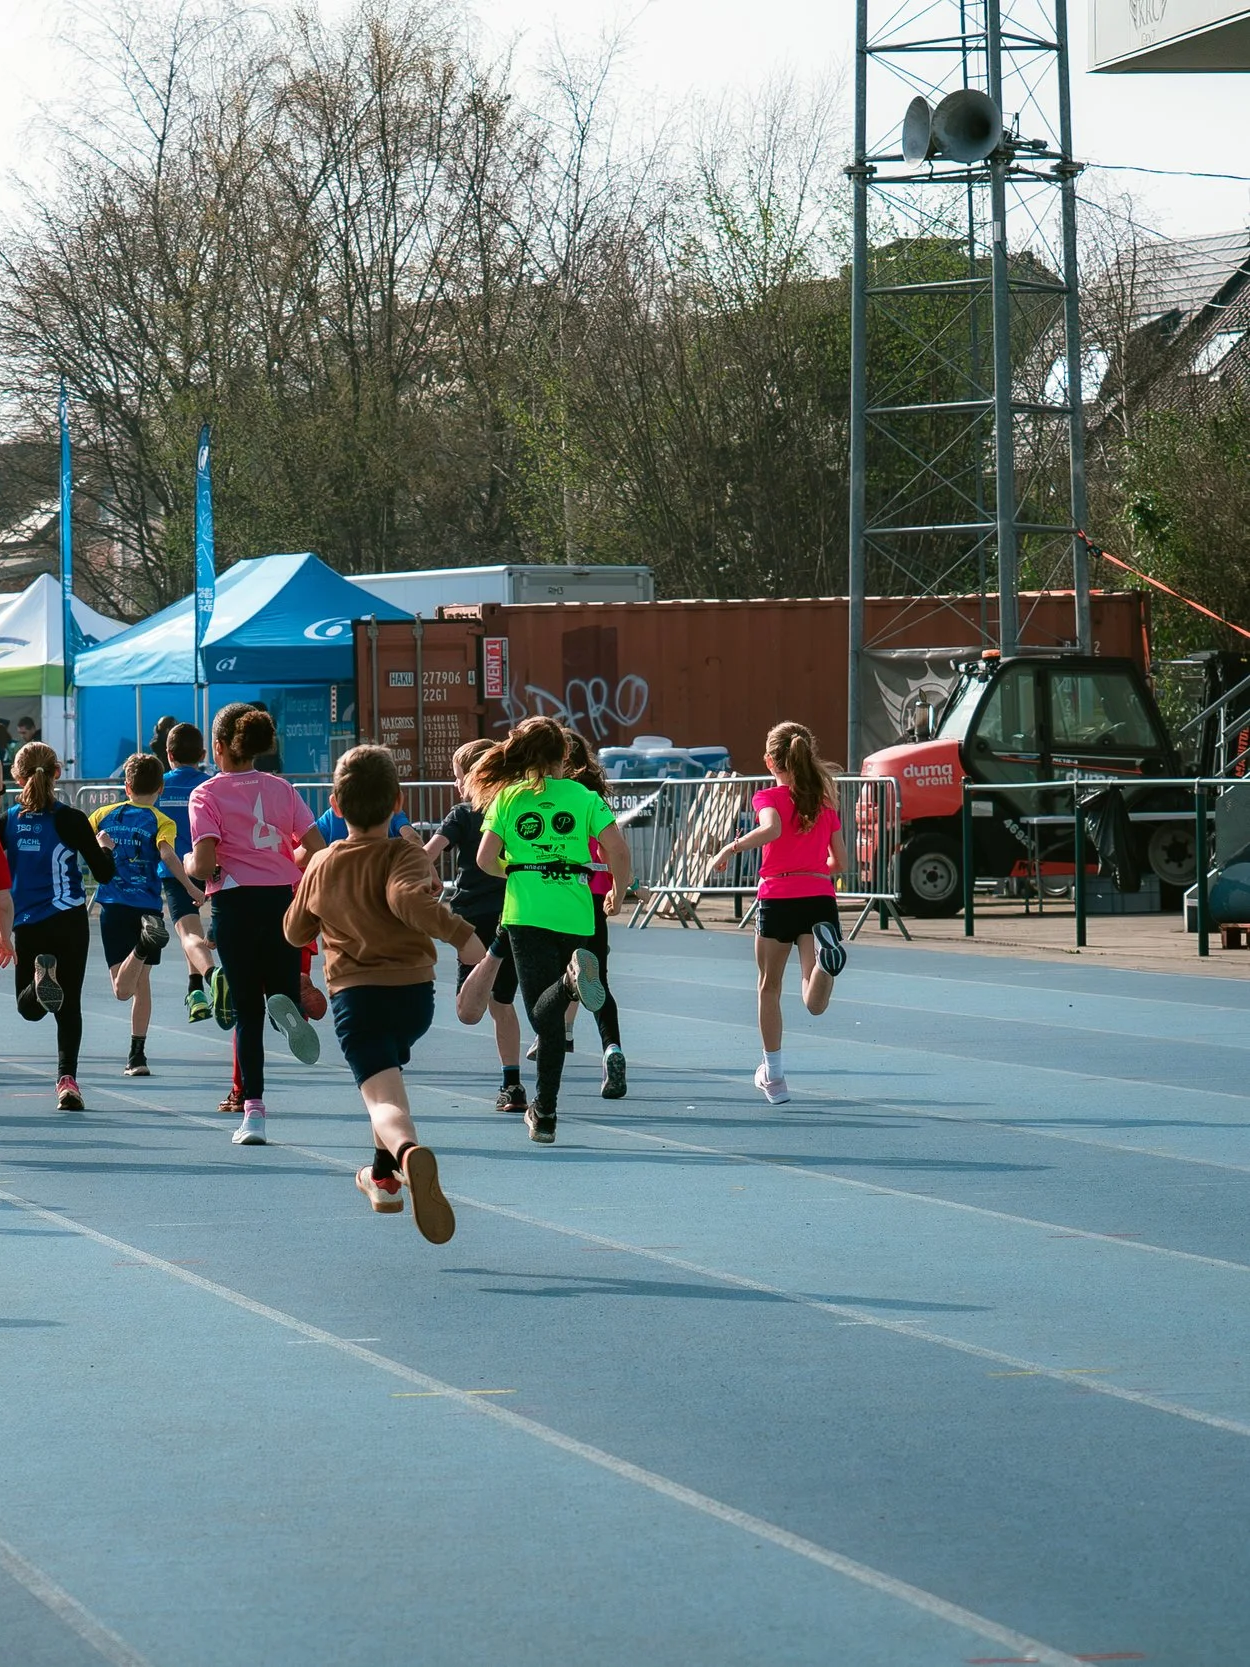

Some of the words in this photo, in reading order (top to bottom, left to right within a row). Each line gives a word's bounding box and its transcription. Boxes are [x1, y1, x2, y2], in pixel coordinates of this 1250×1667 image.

[390, 673, 414, 686] HAKU
[423, 671, 461, 685] 277906
[488, 653, 500, 693] EVENT
[423, 688, 447, 701] 22G1
[382, 732, 399, 745] TARE
[393, 748, 411, 761] LOAD
[903, 764, 953, 779] duma
[621, 795, 637, 809] FOR
[252, 791, 281, 853] 4
[520, 823, 538, 832] Pizza
